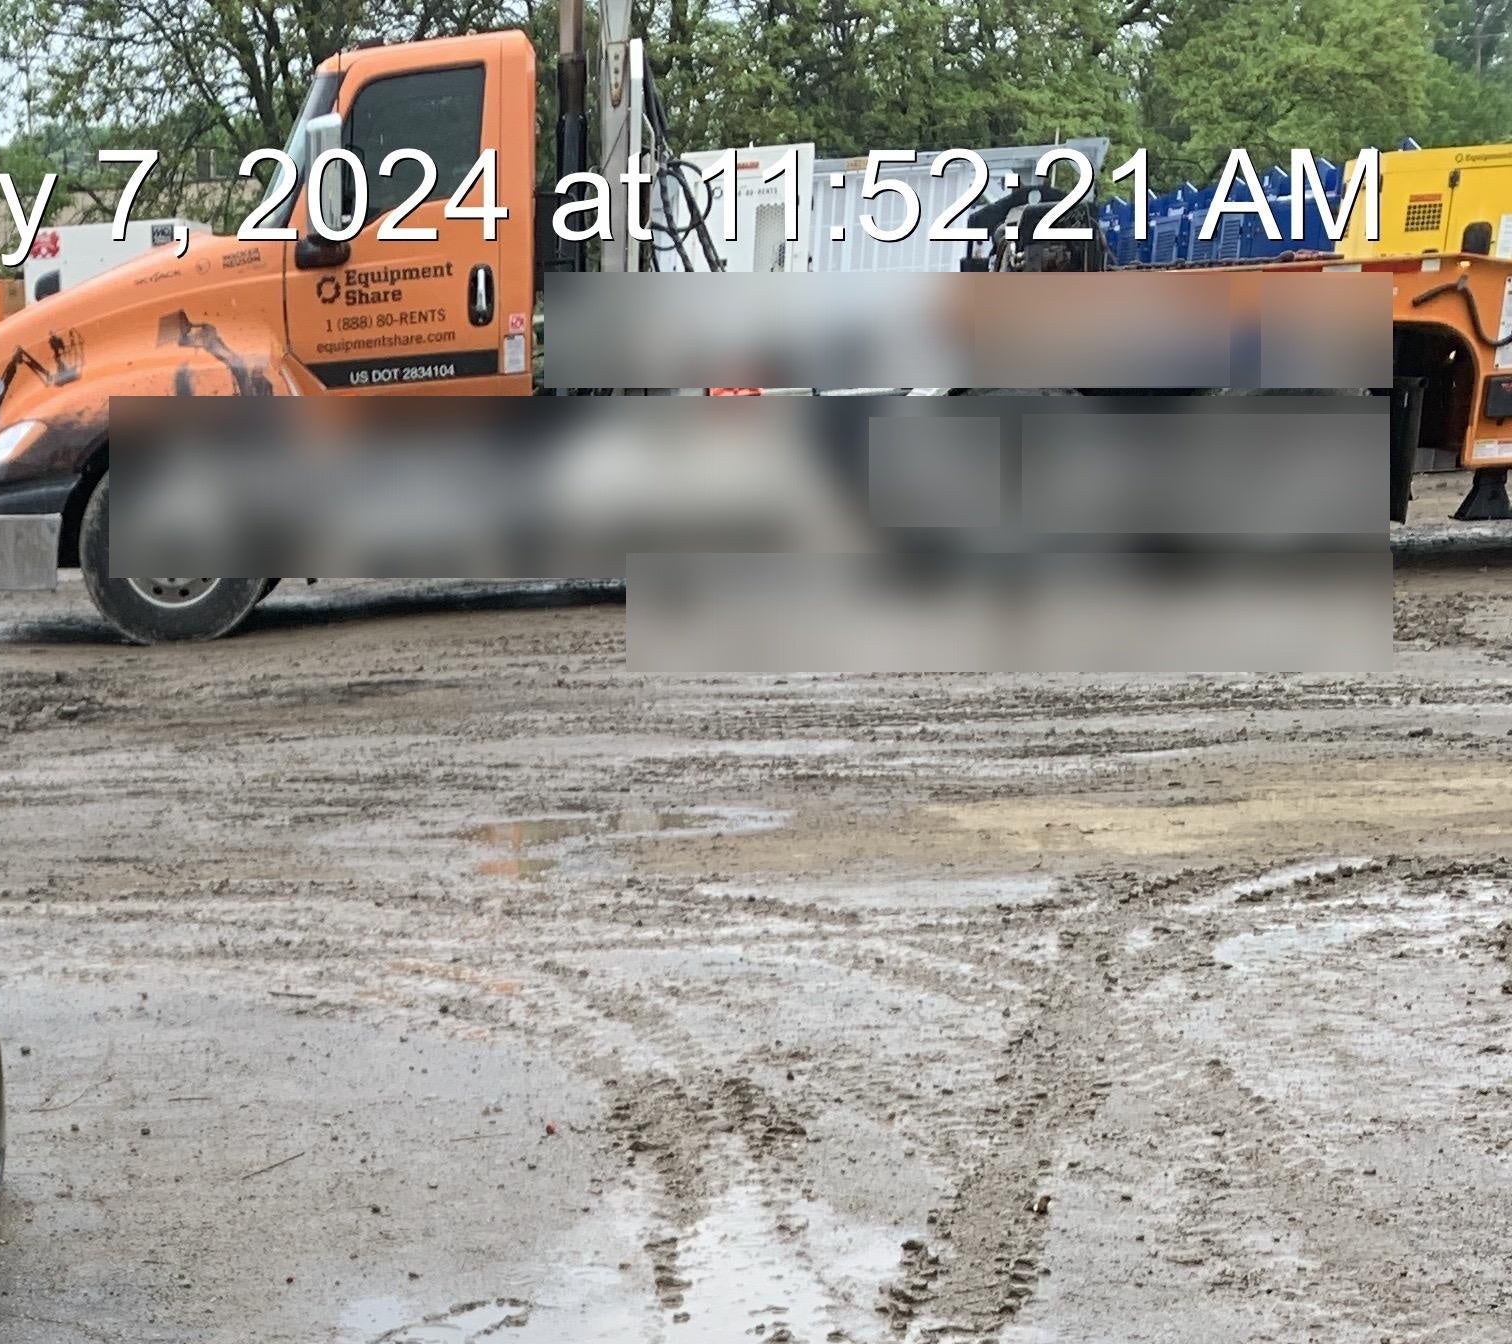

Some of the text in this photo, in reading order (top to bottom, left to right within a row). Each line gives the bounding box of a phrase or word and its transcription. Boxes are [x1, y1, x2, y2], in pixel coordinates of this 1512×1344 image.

[345, 262, 454, 288] Equipment
[345, 287, 402, 306] Share
[325, 309, 446, 332] 1 (888) 80-RENTS
[316, 330, 456, 355] equipmentshare.com
[350, 364, 455, 384] US DOT 2834104
